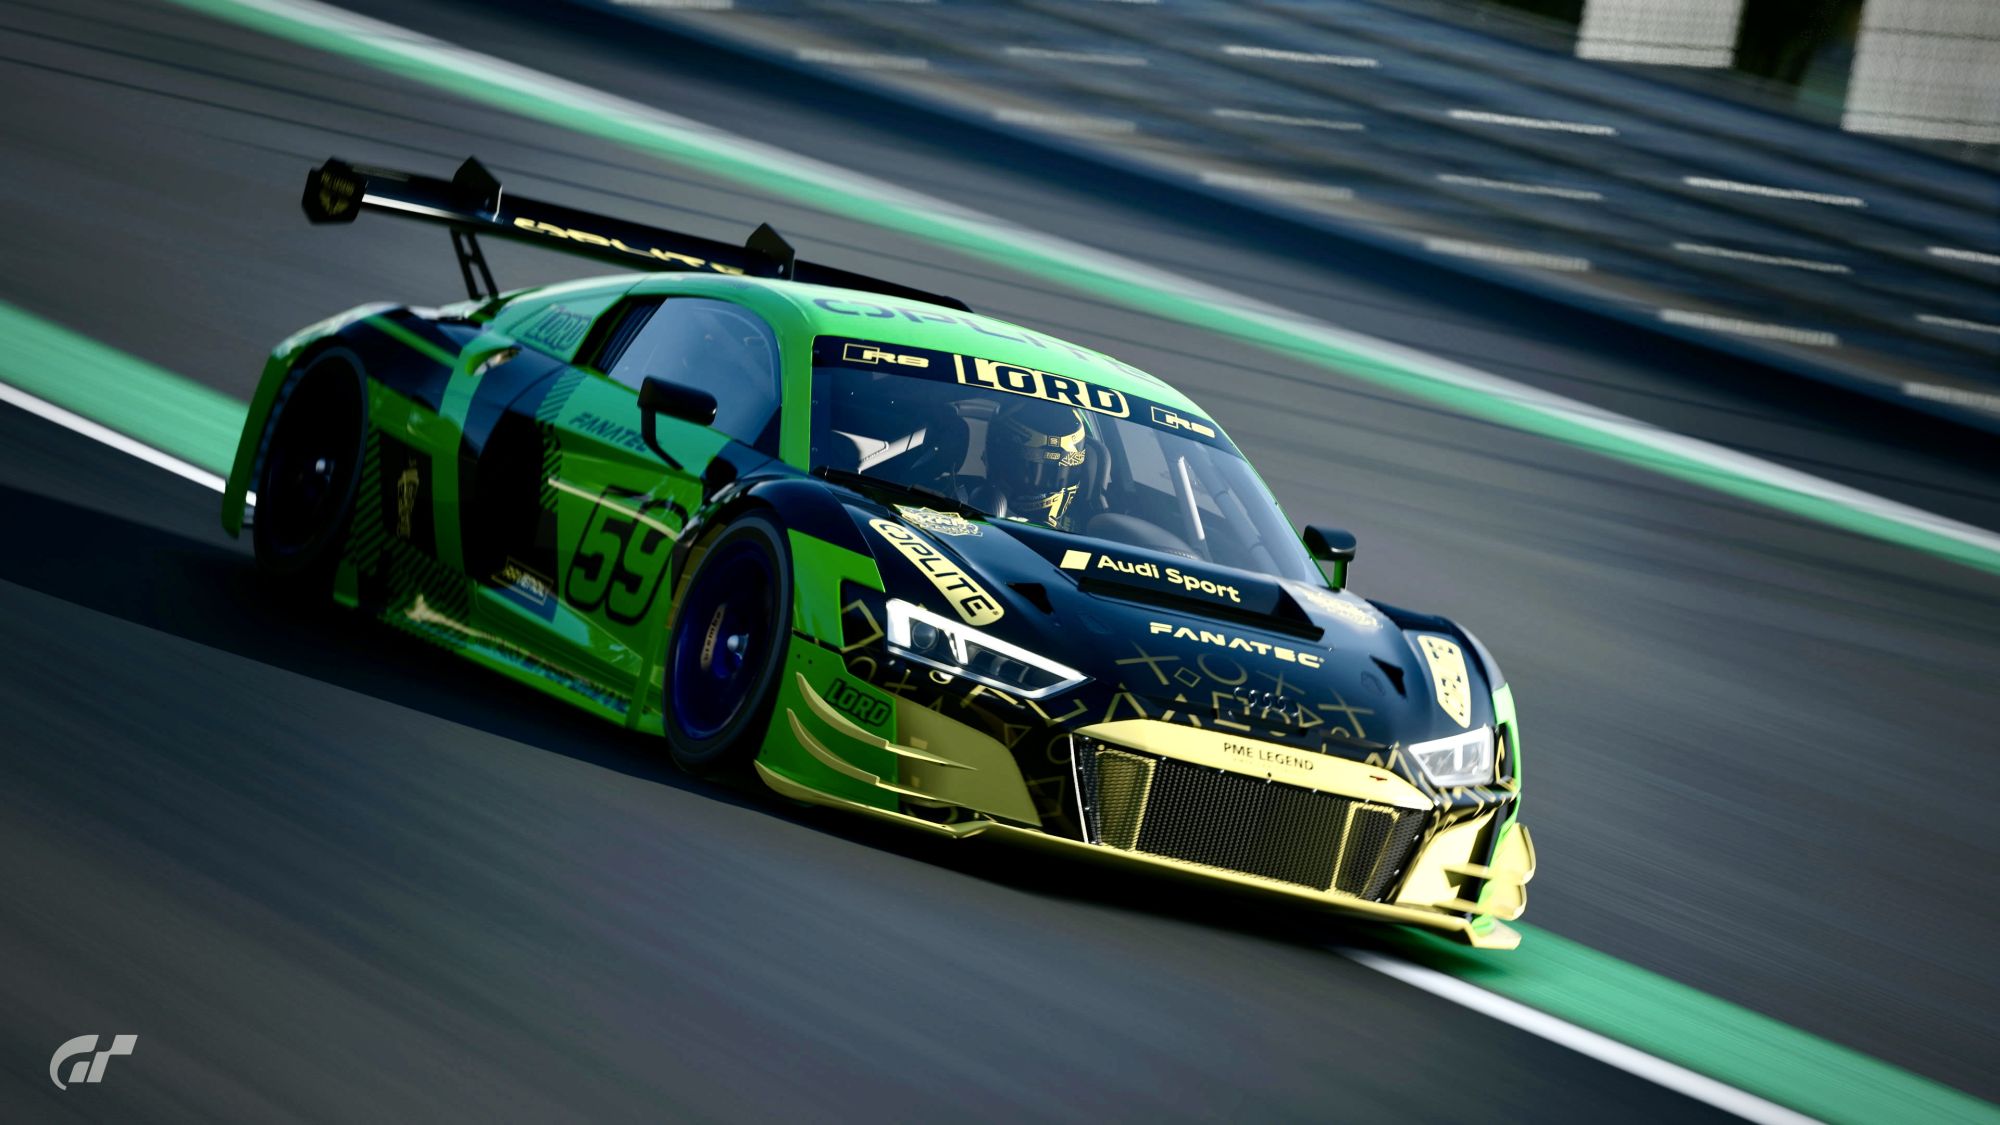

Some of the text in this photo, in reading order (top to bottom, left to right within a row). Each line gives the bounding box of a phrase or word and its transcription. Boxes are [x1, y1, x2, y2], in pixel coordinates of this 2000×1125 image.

[861, 349, 930, 369] R8
[956, 355, 1127, 416] LORD
[564, 484, 690, 627] 59
[879, 523, 995, 618] OPLITE
[1097, 554, 1242, 604] Audi Sport
[1149, 621, 1322, 669] FANATEC
[823, 676, 893, 728] LORD
[1223, 742, 1254, 758] PME
[1258, 749, 1314, 771] LEGEND
